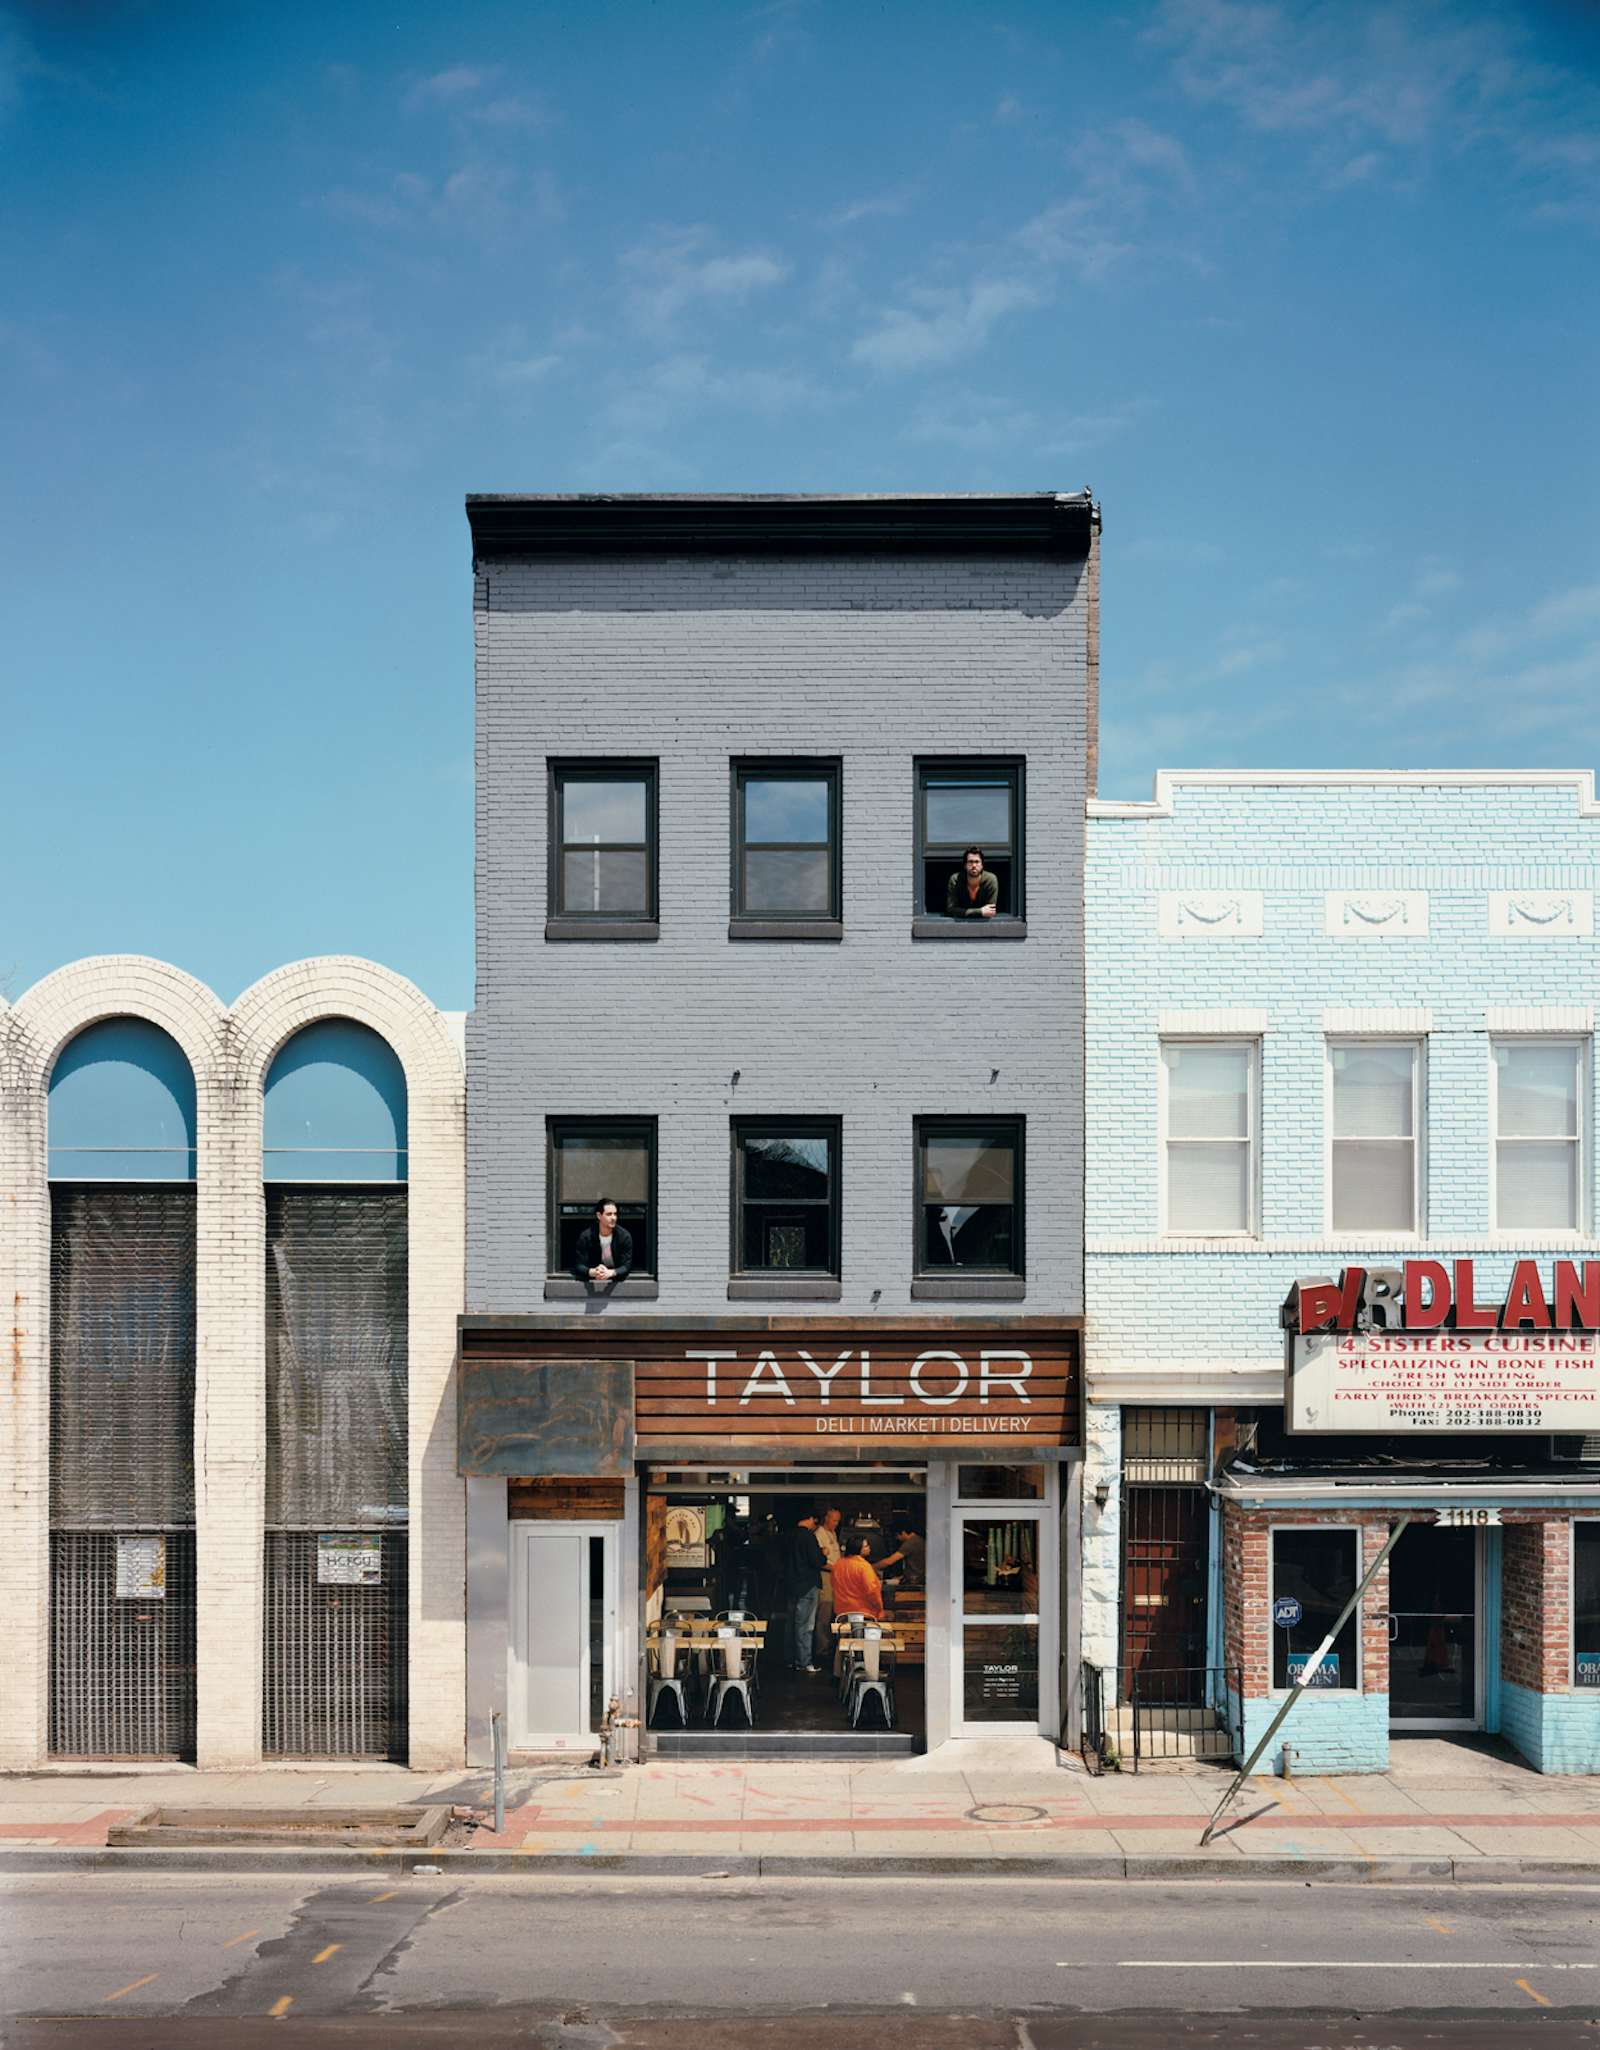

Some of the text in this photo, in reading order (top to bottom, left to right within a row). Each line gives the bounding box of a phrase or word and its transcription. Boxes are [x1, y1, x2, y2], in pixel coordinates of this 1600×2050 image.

[1341, 1338, 1593, 1352] 4 SISTERS CUISINE
[1338, 1359, 1594, 1369] SPECIALIZING IN BONE FISH
[685, 1350, 1033, 1406] TAYLOR
[1443, 1393, 1528, 1401] BREAKFAST
[1535, 1393, 1597, 1401] SPECIAL
[1389, 1409, 1440, 1417] Phone:
[816, 1417, 1032, 1432] DELI MARKET DELIVERY
[1412, 1418, 1440, 1426] Fax:
[1447, 1509, 1488, 1526] 1118
[1277, 1606, 1299, 1619] ADT
[1287, 1663, 1338, 1675] OBMA
